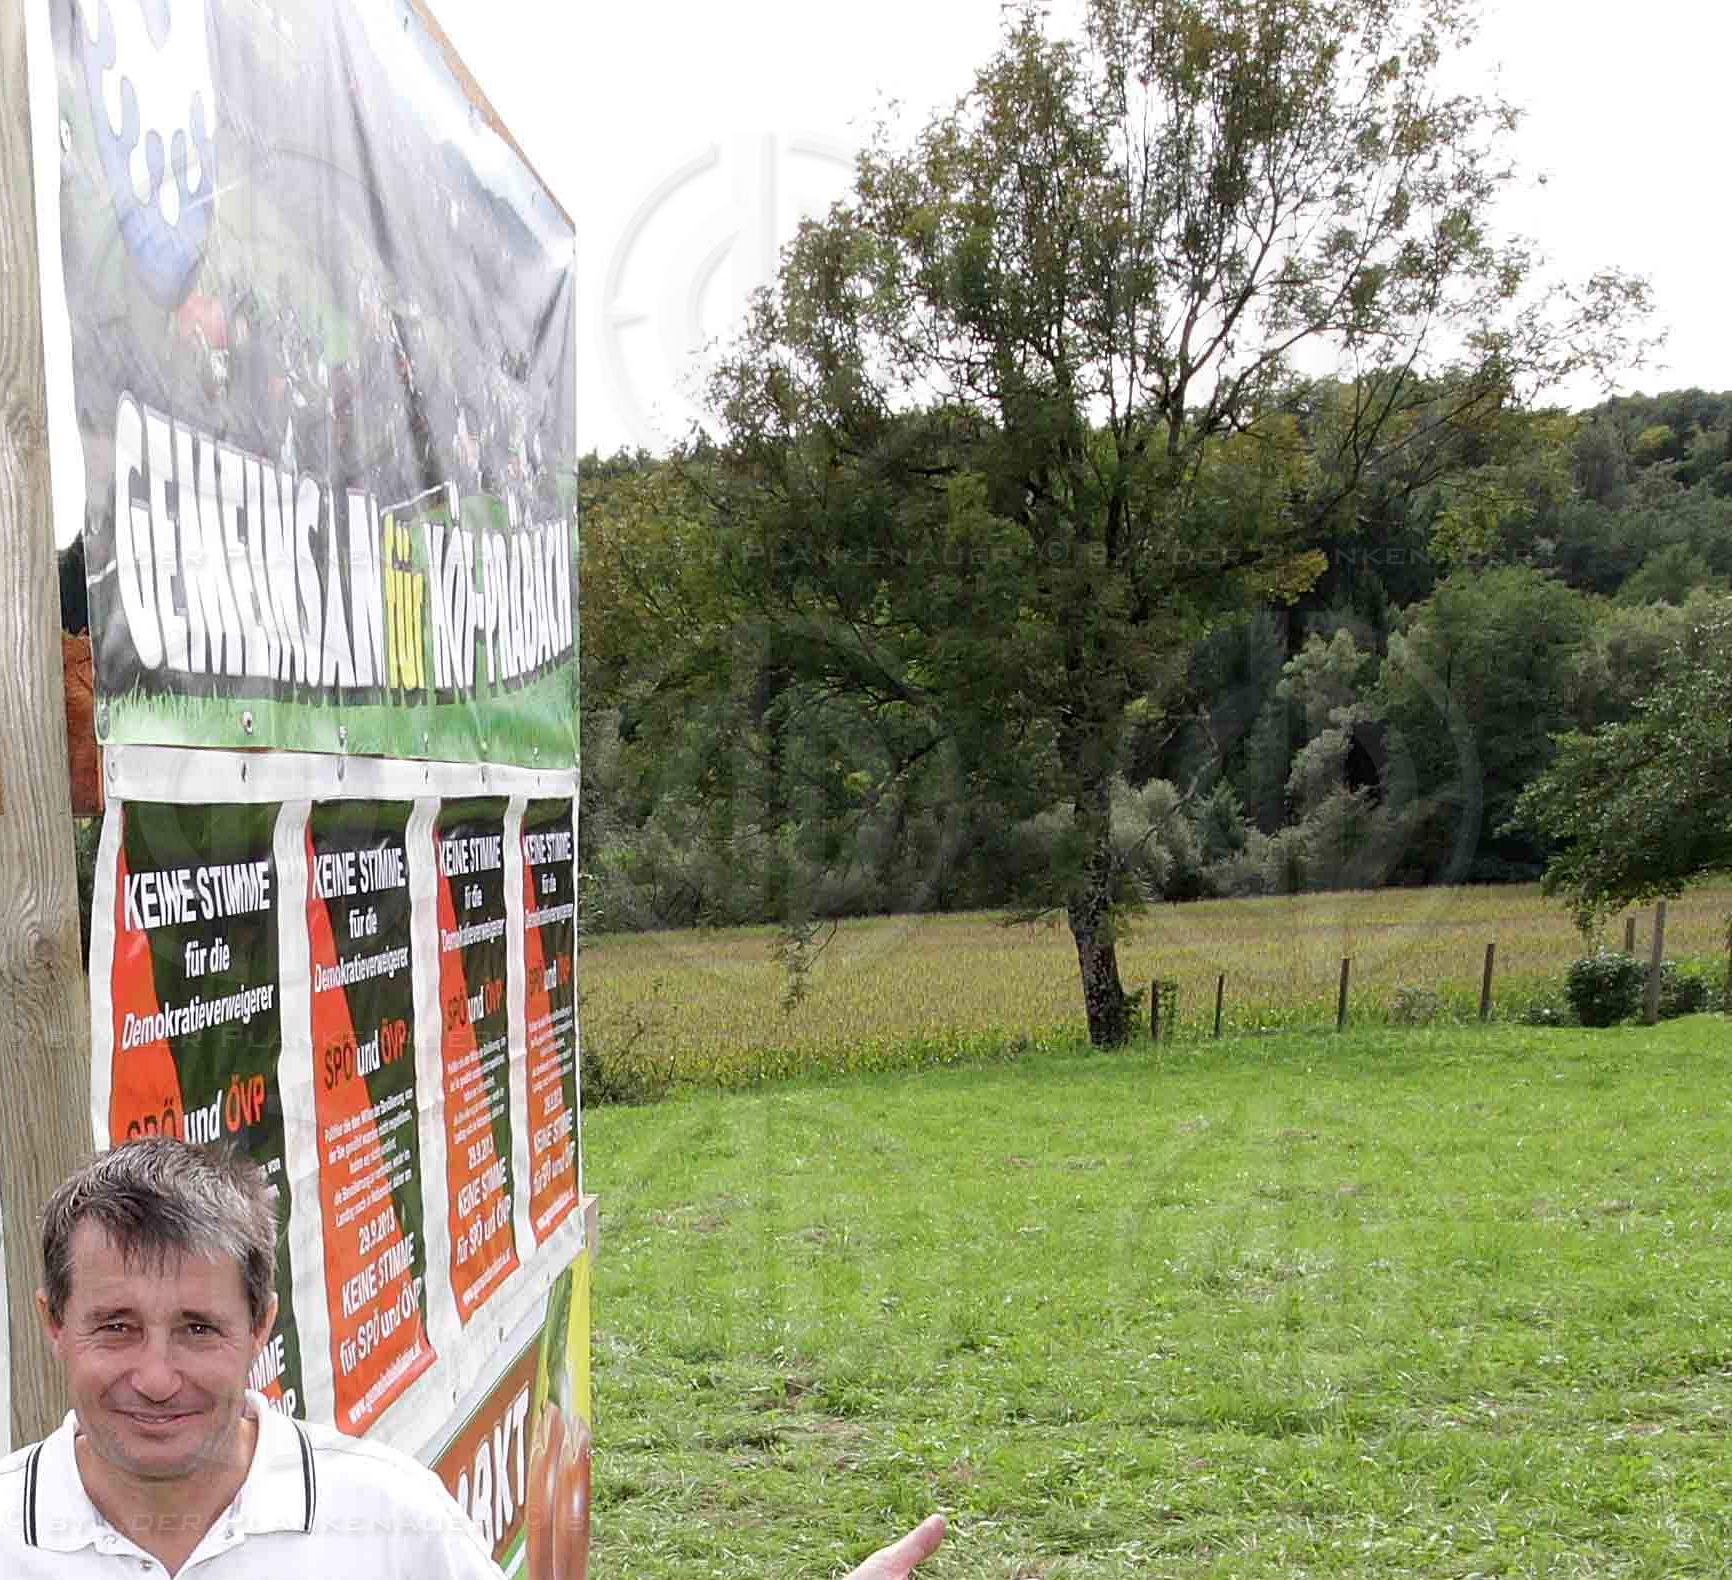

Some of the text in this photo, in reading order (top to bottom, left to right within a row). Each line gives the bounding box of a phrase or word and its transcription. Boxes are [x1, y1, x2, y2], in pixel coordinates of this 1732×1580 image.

[381, 512, 426, 690] für
[124, 861, 270, 931] KEINE STIMME
[312, 847, 406, 900] KEINE STIMME
[185, 937, 230, 978] für die
[122, 984, 274, 1051] Demokratieverweigerer
[357, 1039, 381, 1076] und
[381, 1017, 407, 1063] ÖVP
[183, 1089, 223, 1144] und
[225, 1074, 266, 1133] ÖVP
[342, 1264, 377, 1319] KEINE
[377, 1231, 416, 1288] STIMME
